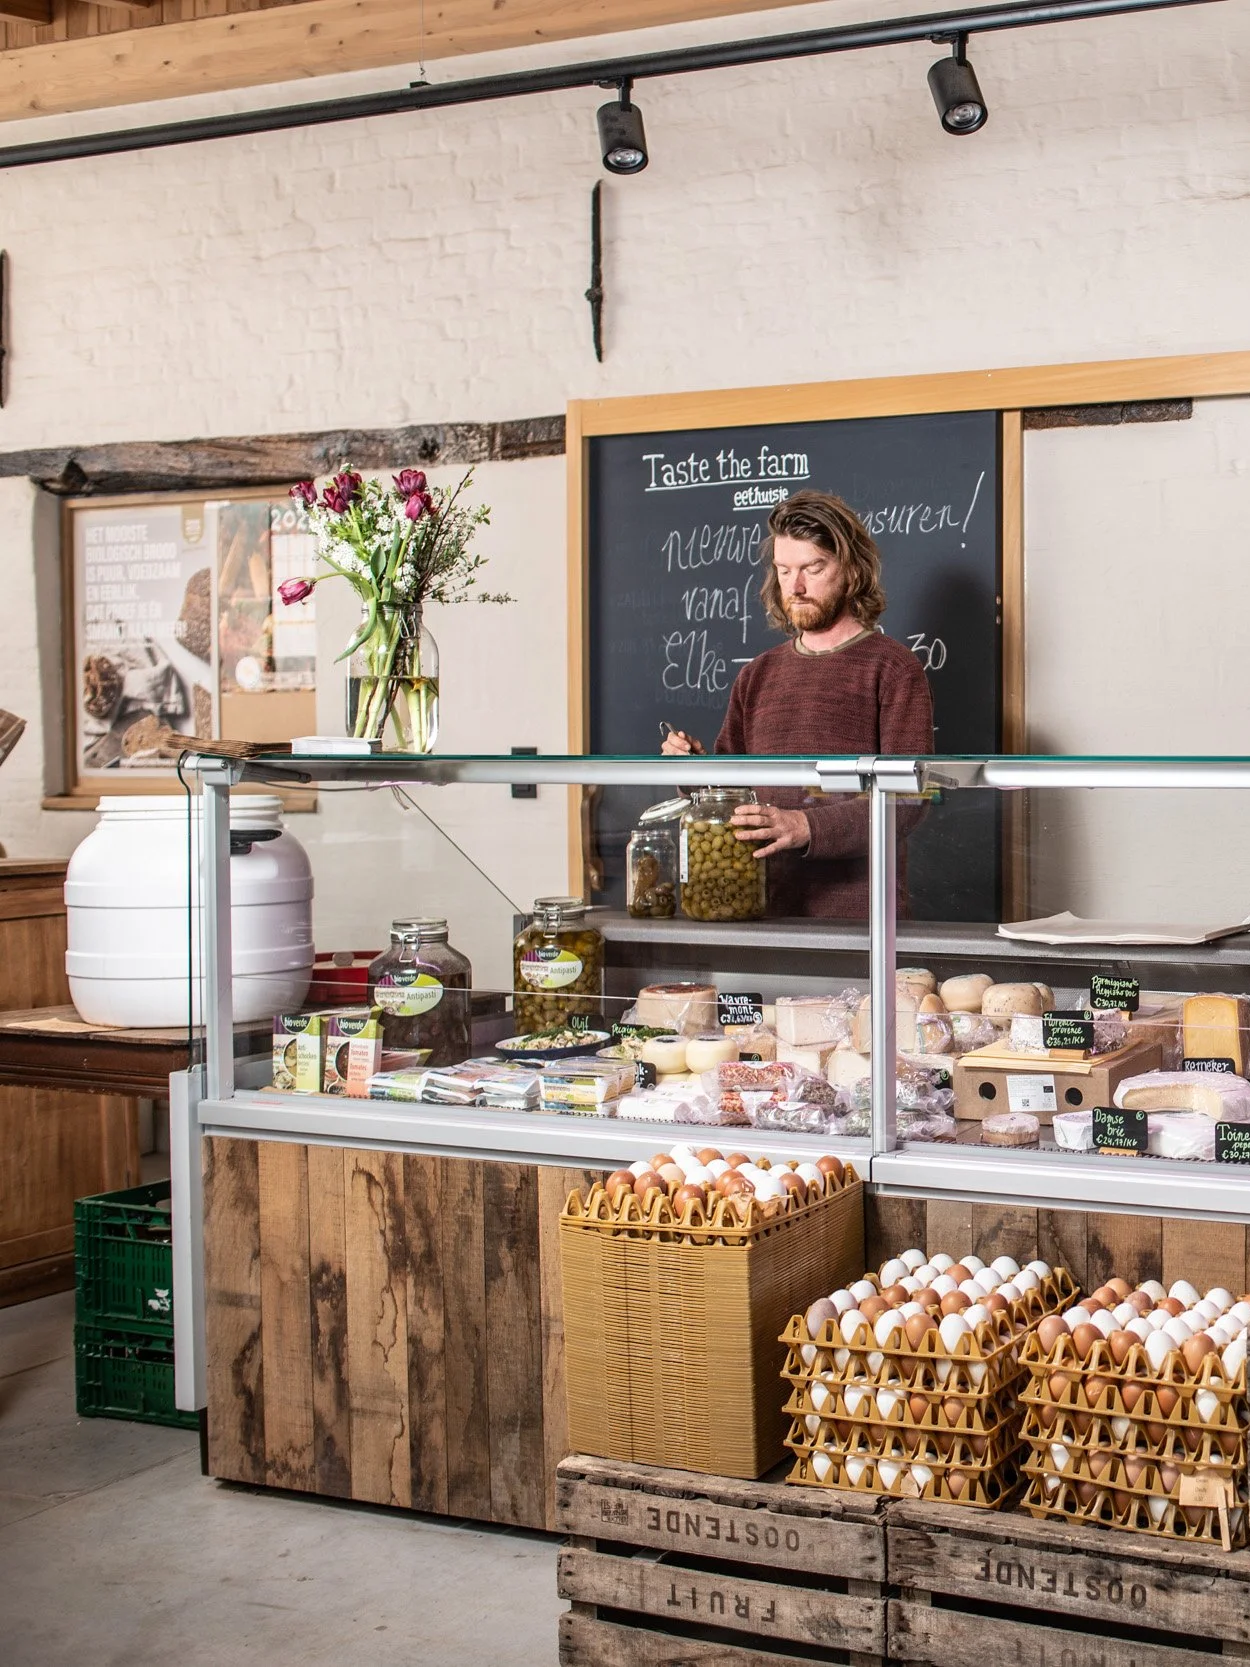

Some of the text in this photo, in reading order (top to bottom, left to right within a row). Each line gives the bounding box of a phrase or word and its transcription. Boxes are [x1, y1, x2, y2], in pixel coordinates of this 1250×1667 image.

[642, 446, 810, 488] Taste the farm
[733, 486, 789, 507] eethuisje
[86, 524, 148, 543] HET MOOISTE
[681, 575, 752, 644] vanaf
[662, 630, 729, 693] Elke
[549, 965, 577, 976] Antipasti
[406, 989, 437, 1001] Antipasti
[1094, 1109, 1124, 1124] Damse
[1107, 1125, 1126, 1136] brie
[1216, 1124, 1250, 1141] Toine
[646, 1506, 801, 1552] OOSTENDE
[974, 1556, 1148, 1609] OOSTENDE
[666, 1583, 776, 1623] FRUIT
